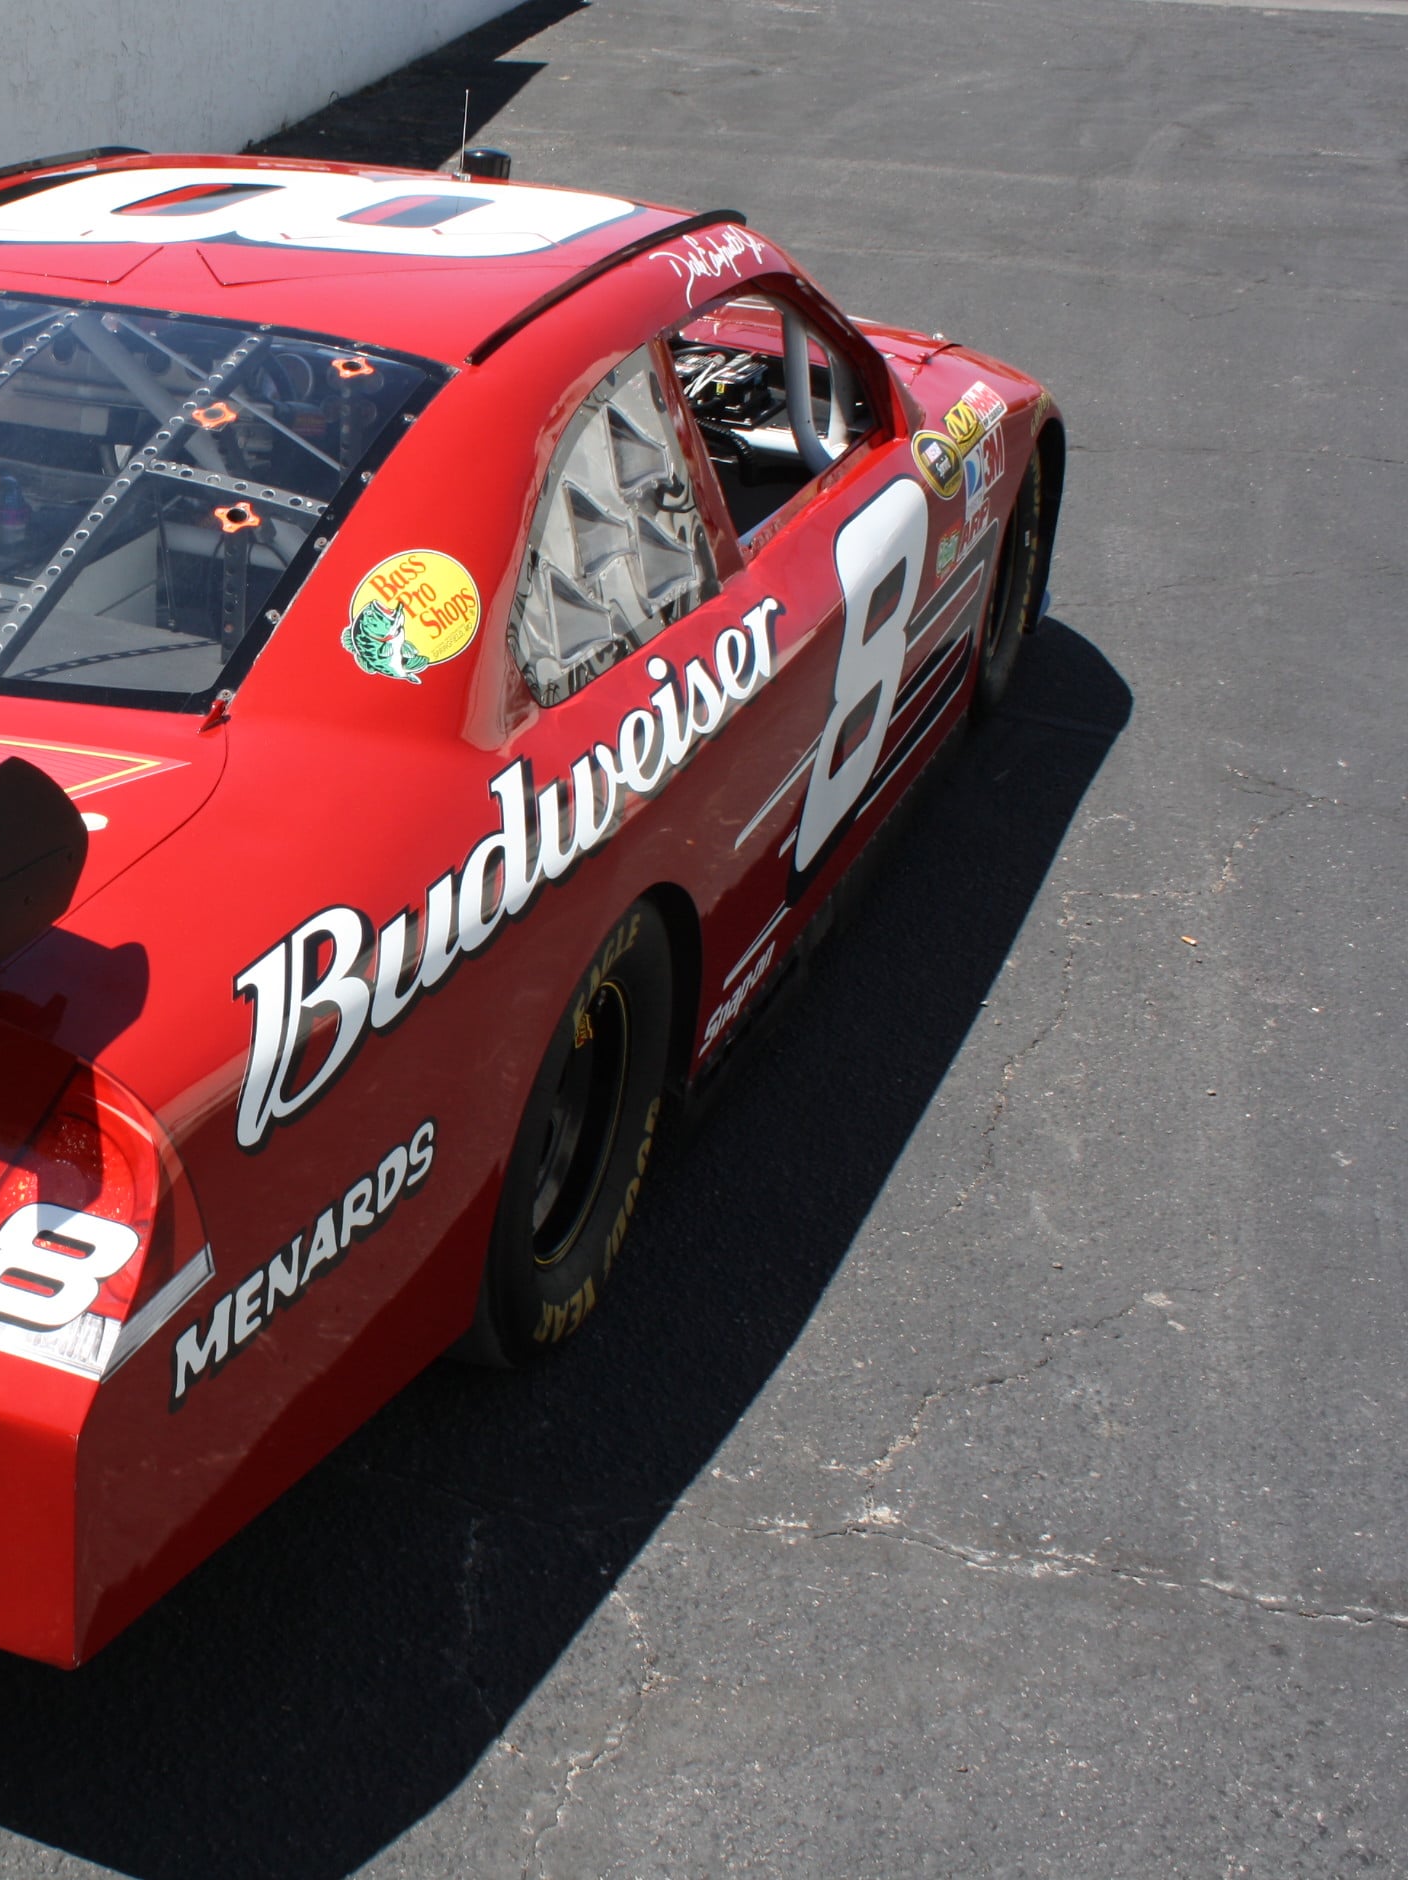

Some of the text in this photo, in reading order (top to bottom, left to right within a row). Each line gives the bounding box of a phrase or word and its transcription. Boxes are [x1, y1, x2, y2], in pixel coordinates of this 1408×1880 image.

[369, 555, 426, 602] Bass
[395, 582, 437, 619] Pro
[419, 587, 476, 640] Shops
[790, 476, 929, 873] 8
[233, 596, 786, 1150] Budweiser
[171, 1118, 437, 1407] MENARDS
